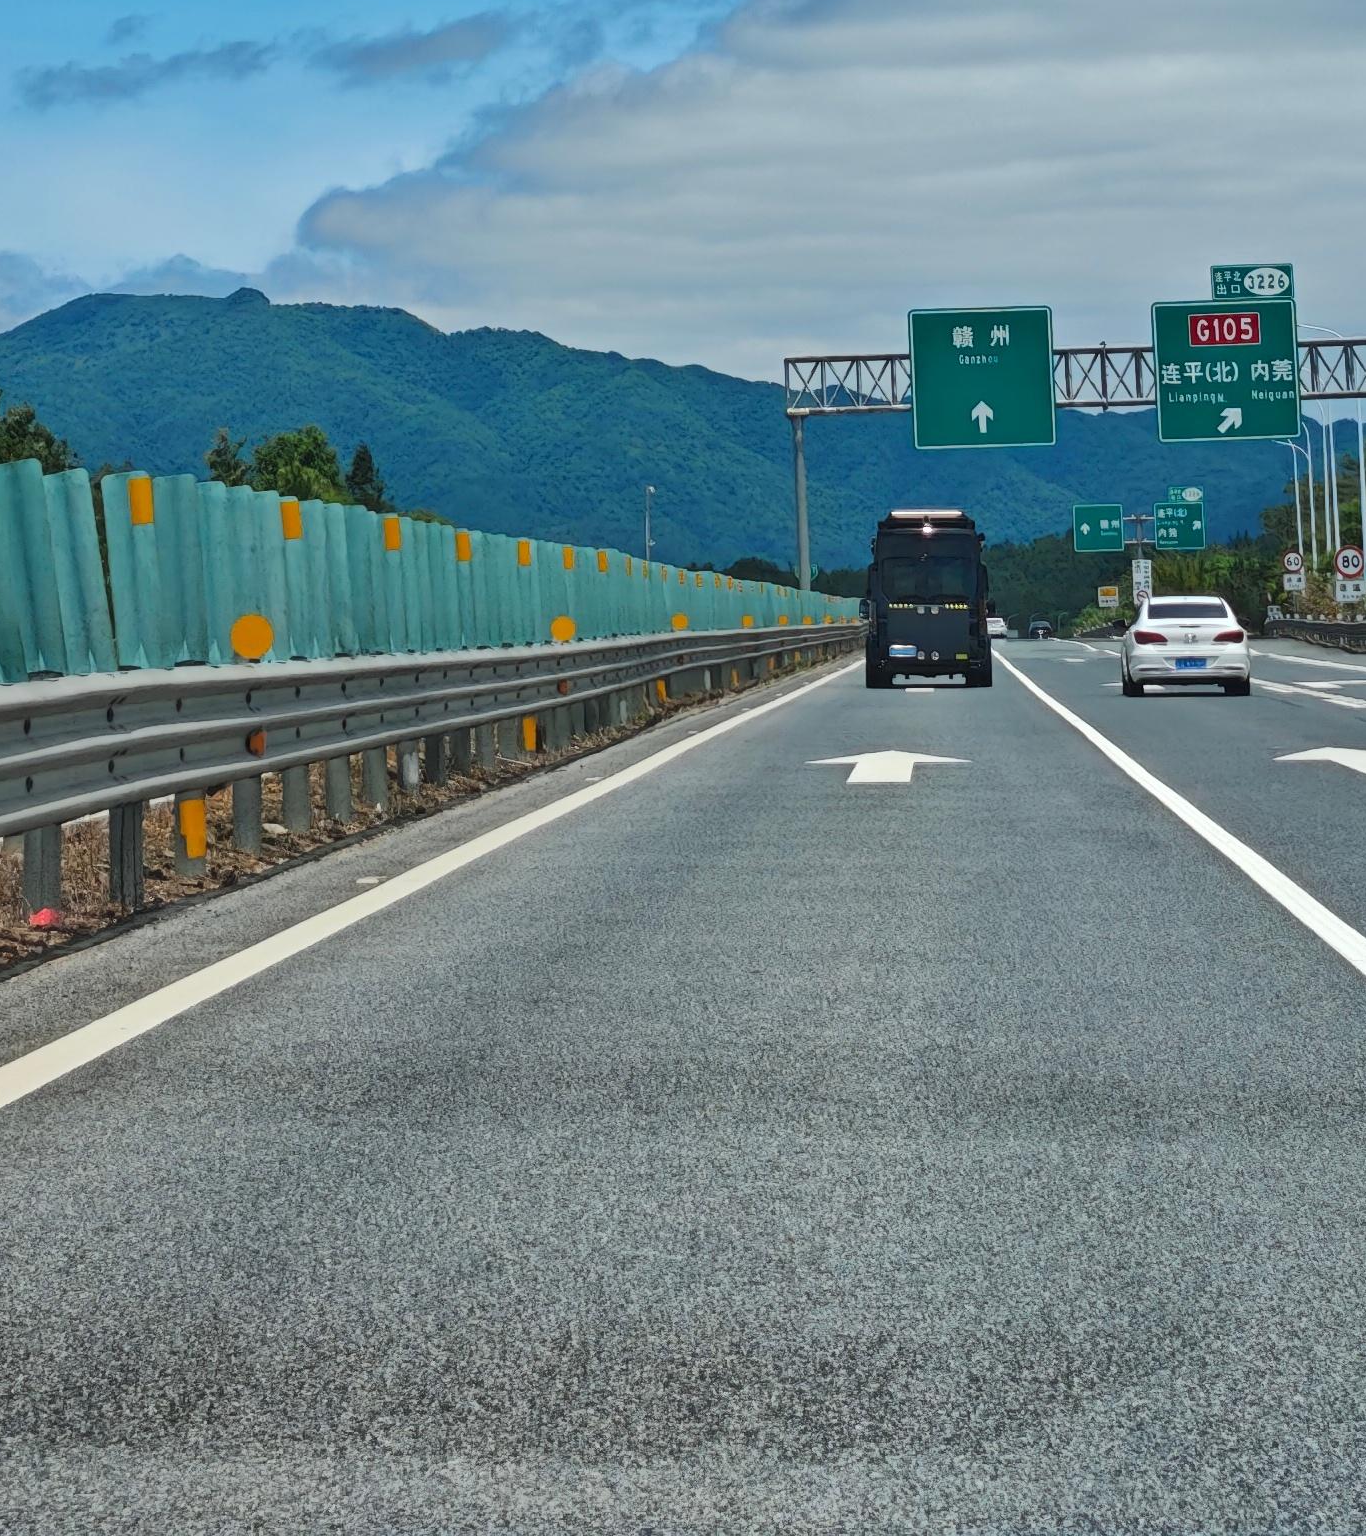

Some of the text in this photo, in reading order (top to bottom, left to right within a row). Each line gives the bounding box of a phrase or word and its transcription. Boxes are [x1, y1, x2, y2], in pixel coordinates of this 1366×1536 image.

[1247, 273, 1285, 290] 3226
[1216, 284, 1241, 295] 出口
[952, 324, 1010, 349] 赣州
[1196, 317, 1253, 342] G105
[958, 354, 999, 365] Ganzhou
[1161, 359, 1293, 384] 连平(北) 内莞
[1286, 557, 1300, 566] 60
[1342, 555, 1360, 569] 80
